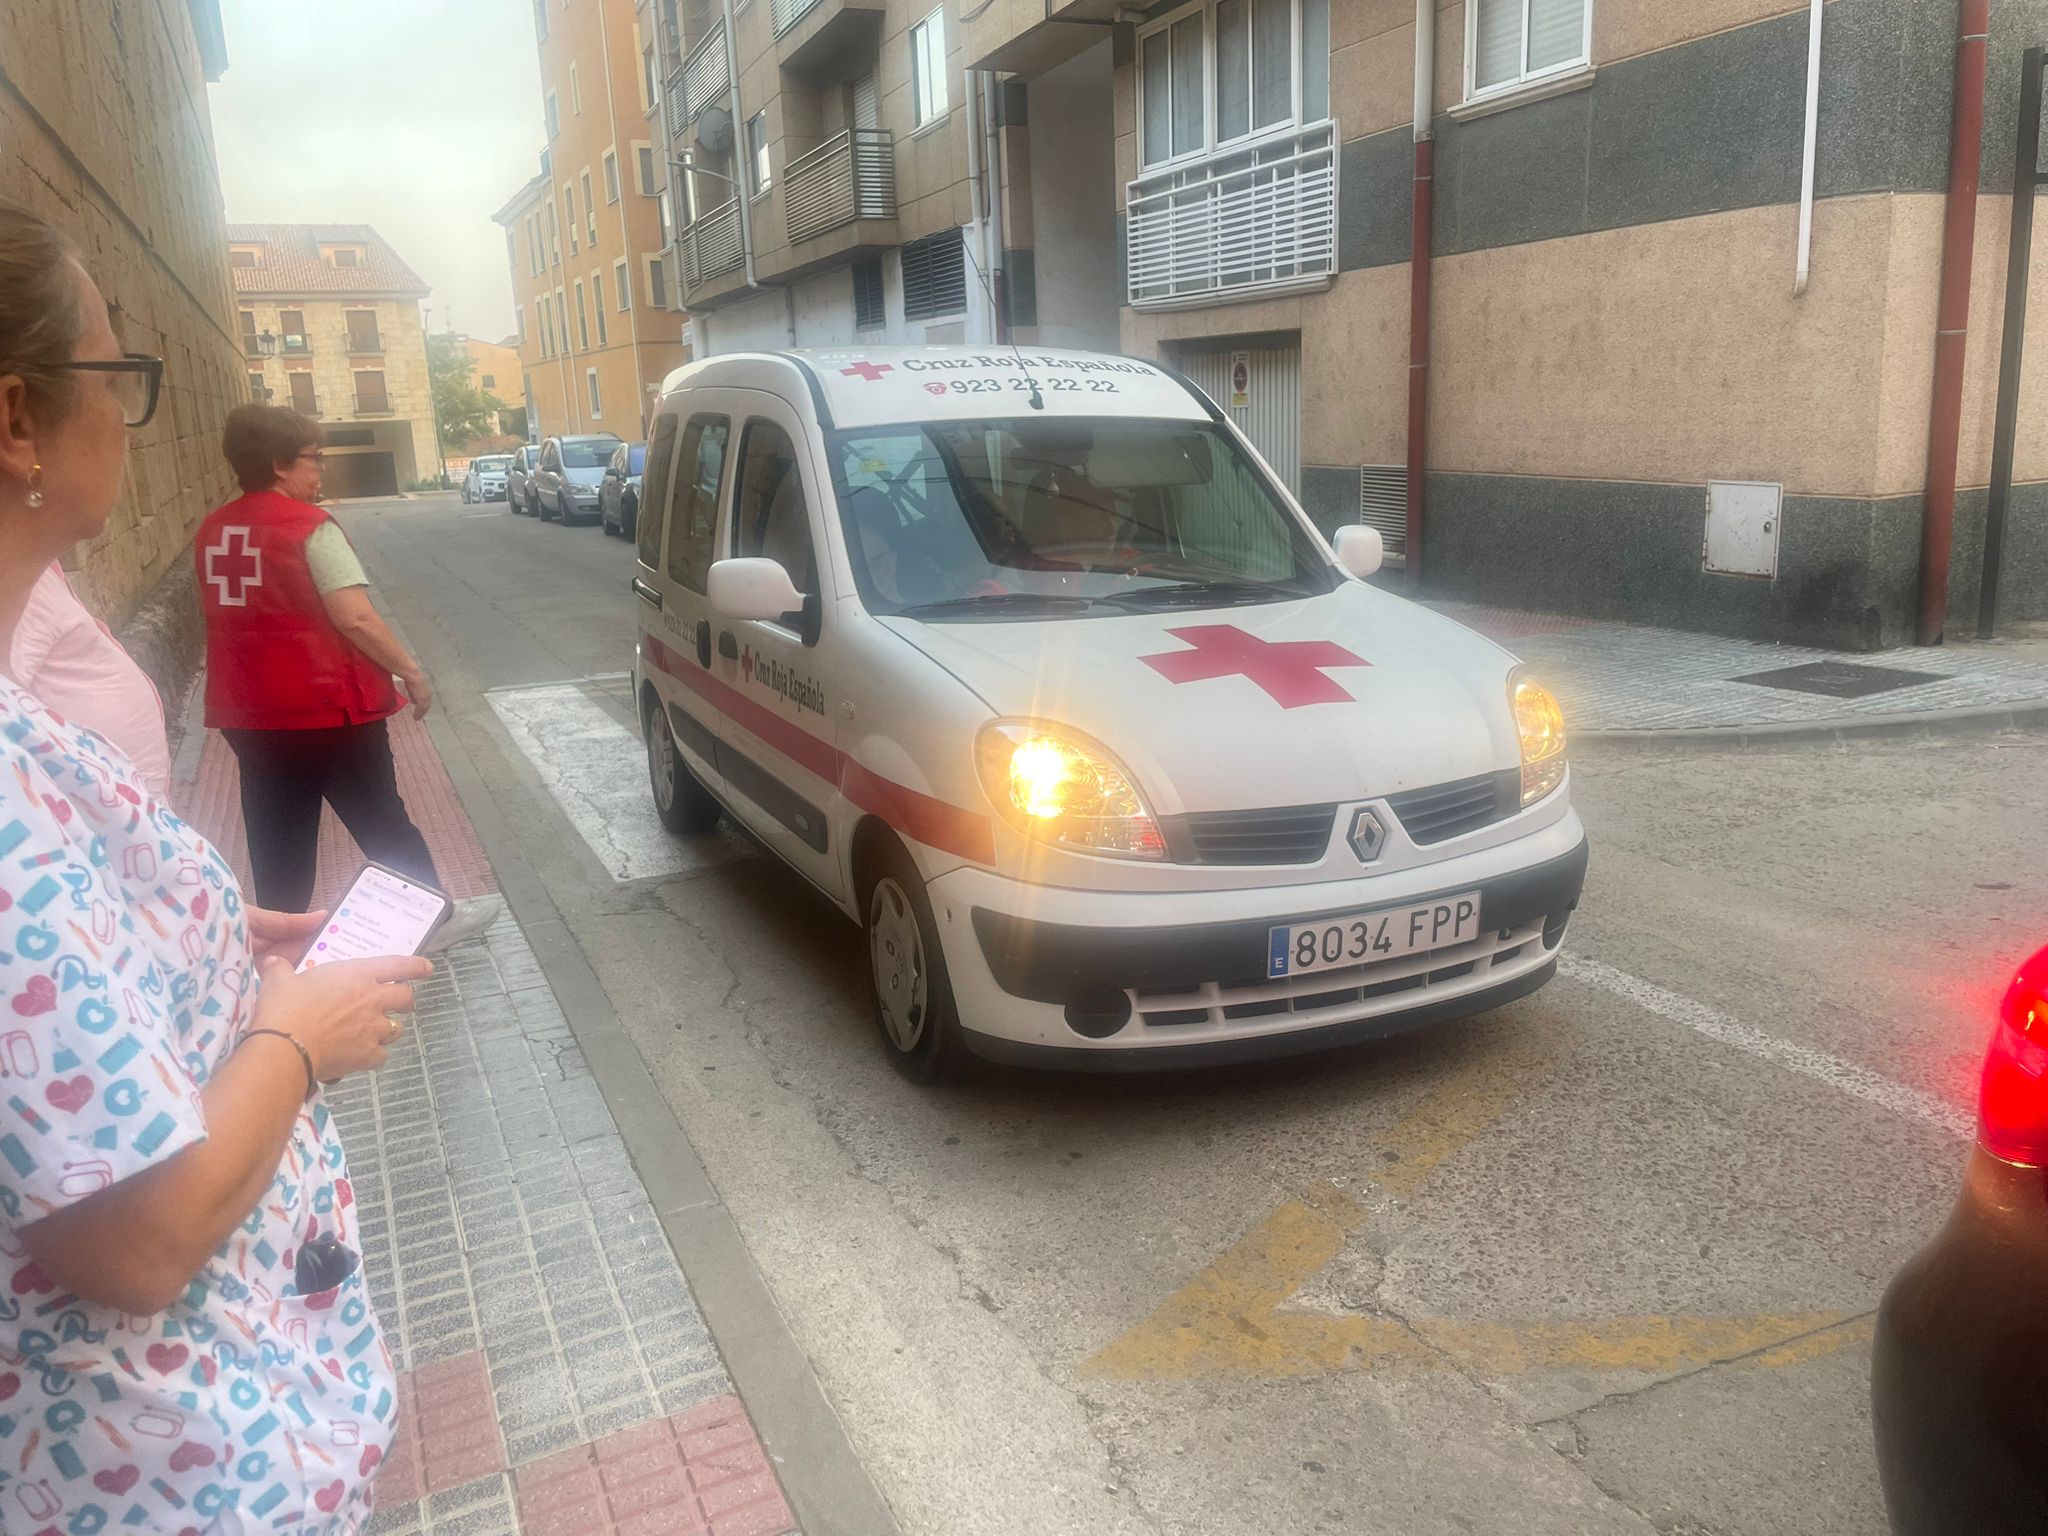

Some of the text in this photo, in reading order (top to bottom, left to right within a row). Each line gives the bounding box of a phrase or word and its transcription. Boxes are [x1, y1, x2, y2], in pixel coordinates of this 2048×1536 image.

[902, 355, 1157, 376] Cruz Roja Española
[950, 378, 1120, 394] 923 22 22 22
[754, 651, 825, 716] Cruz Roja Española
[1295, 900, 1473, 967] 8034 FPP
[1275, 957, 1284, 969] E
